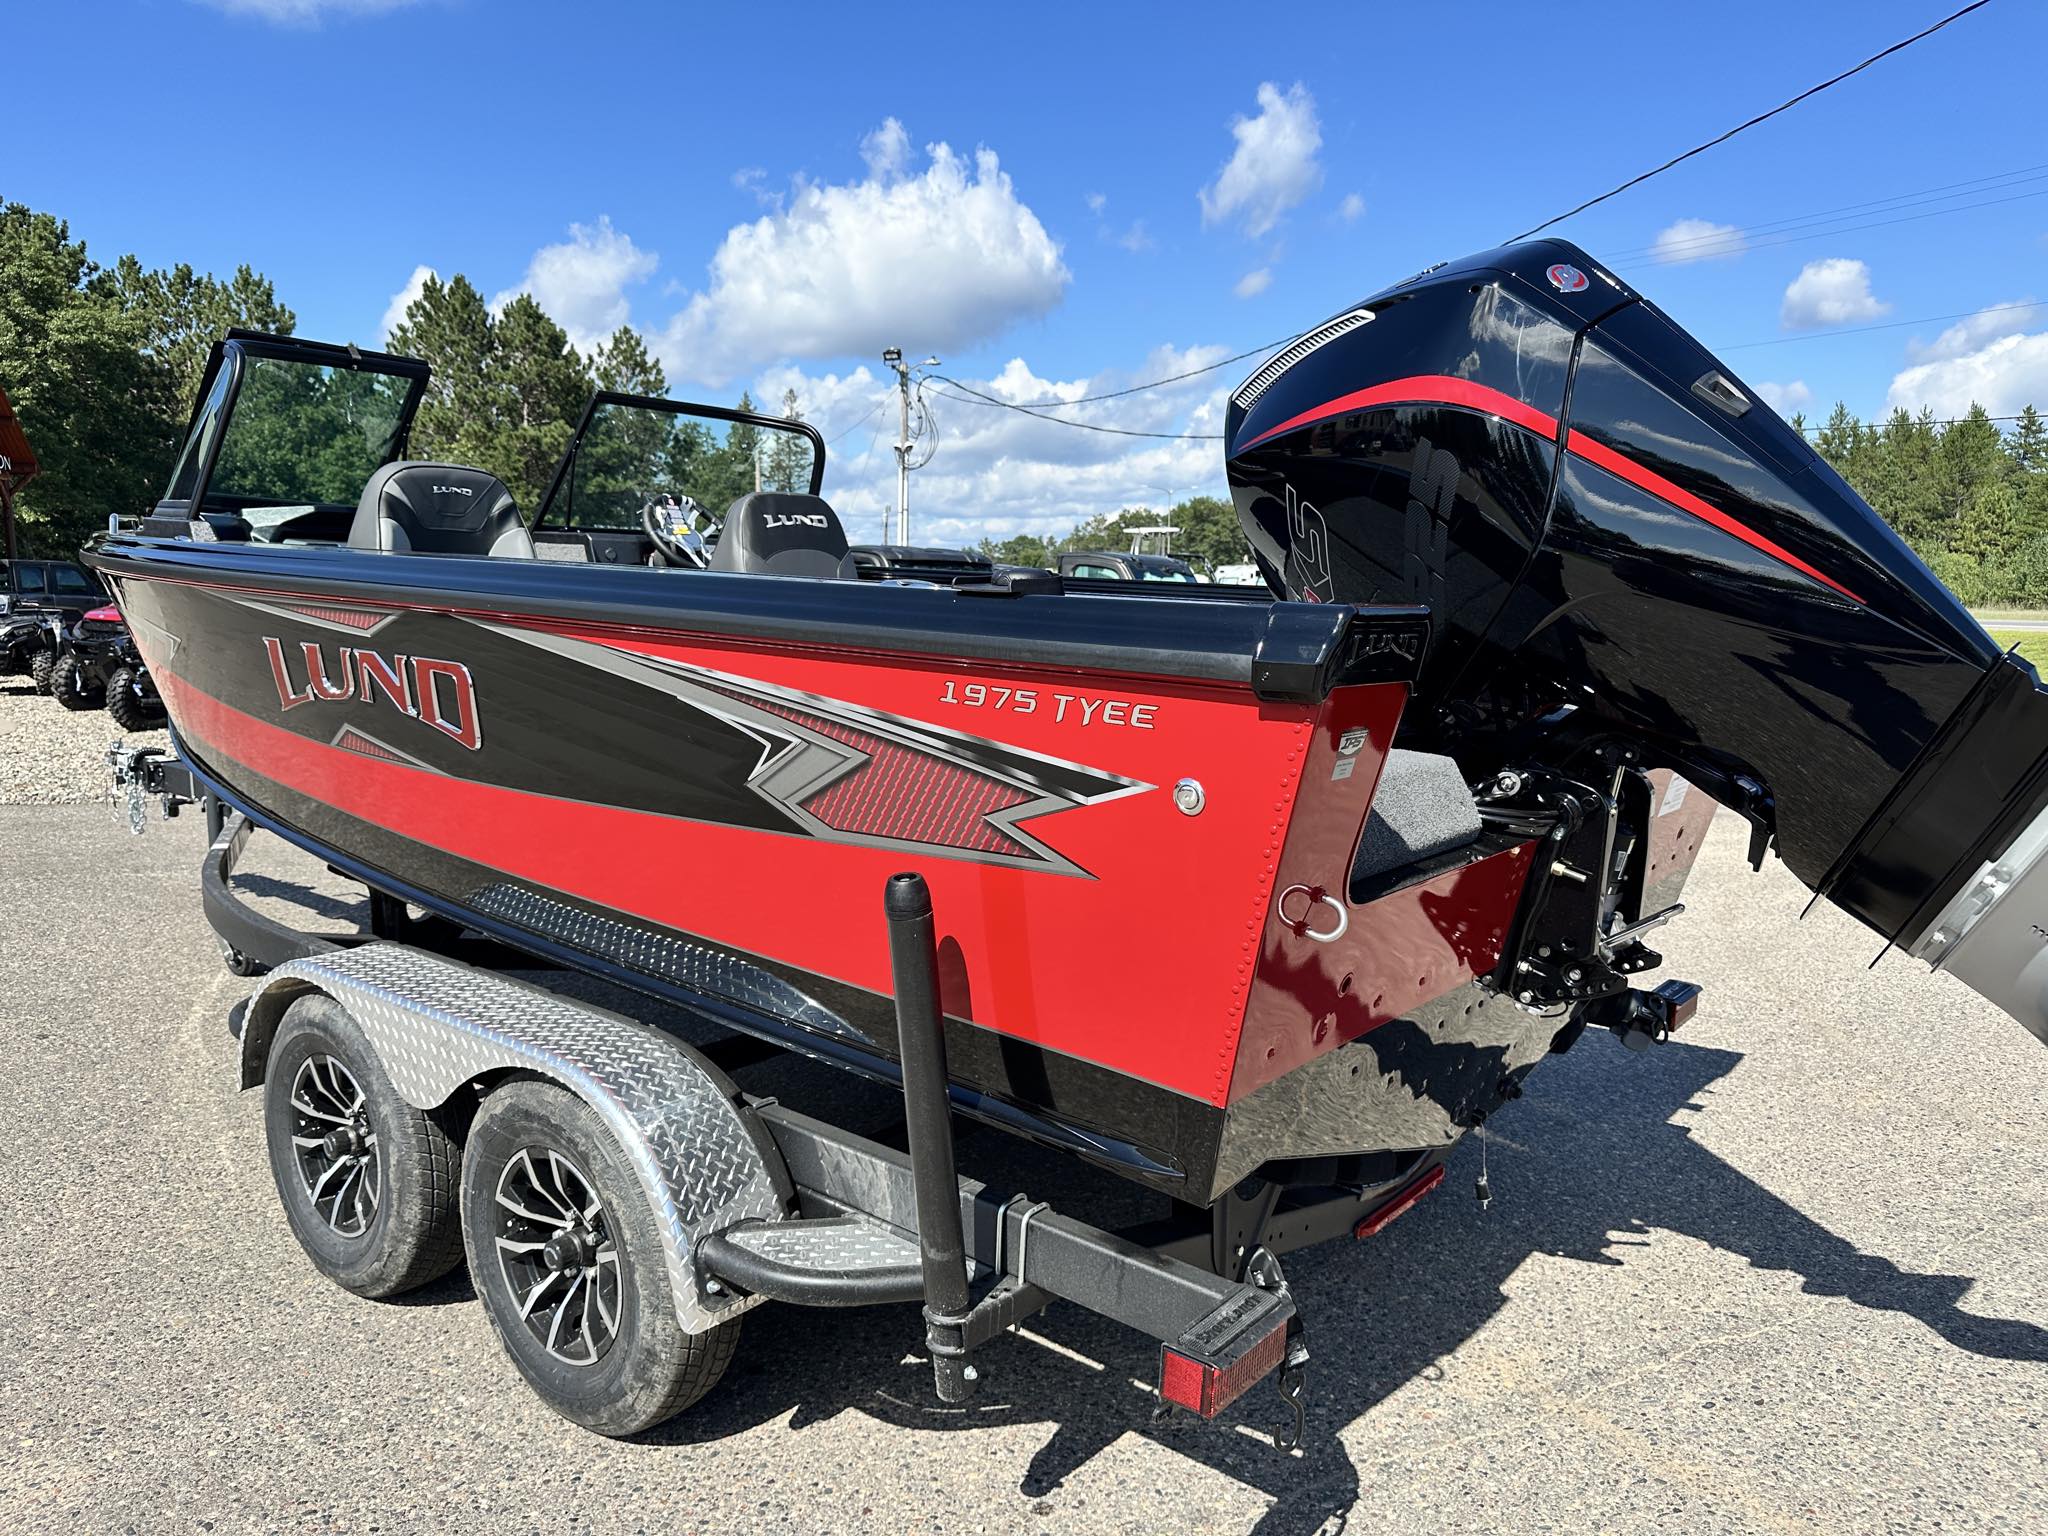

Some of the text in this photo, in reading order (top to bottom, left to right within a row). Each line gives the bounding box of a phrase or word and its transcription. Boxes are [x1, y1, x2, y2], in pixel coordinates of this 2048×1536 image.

[432, 485, 473, 497] LUND
[763, 514, 828, 528] LUND
[1345, 634, 1419, 668] LUND
[262, 636, 482, 751] LUND
[939, 681, 1161, 729] 1975 TYEE
